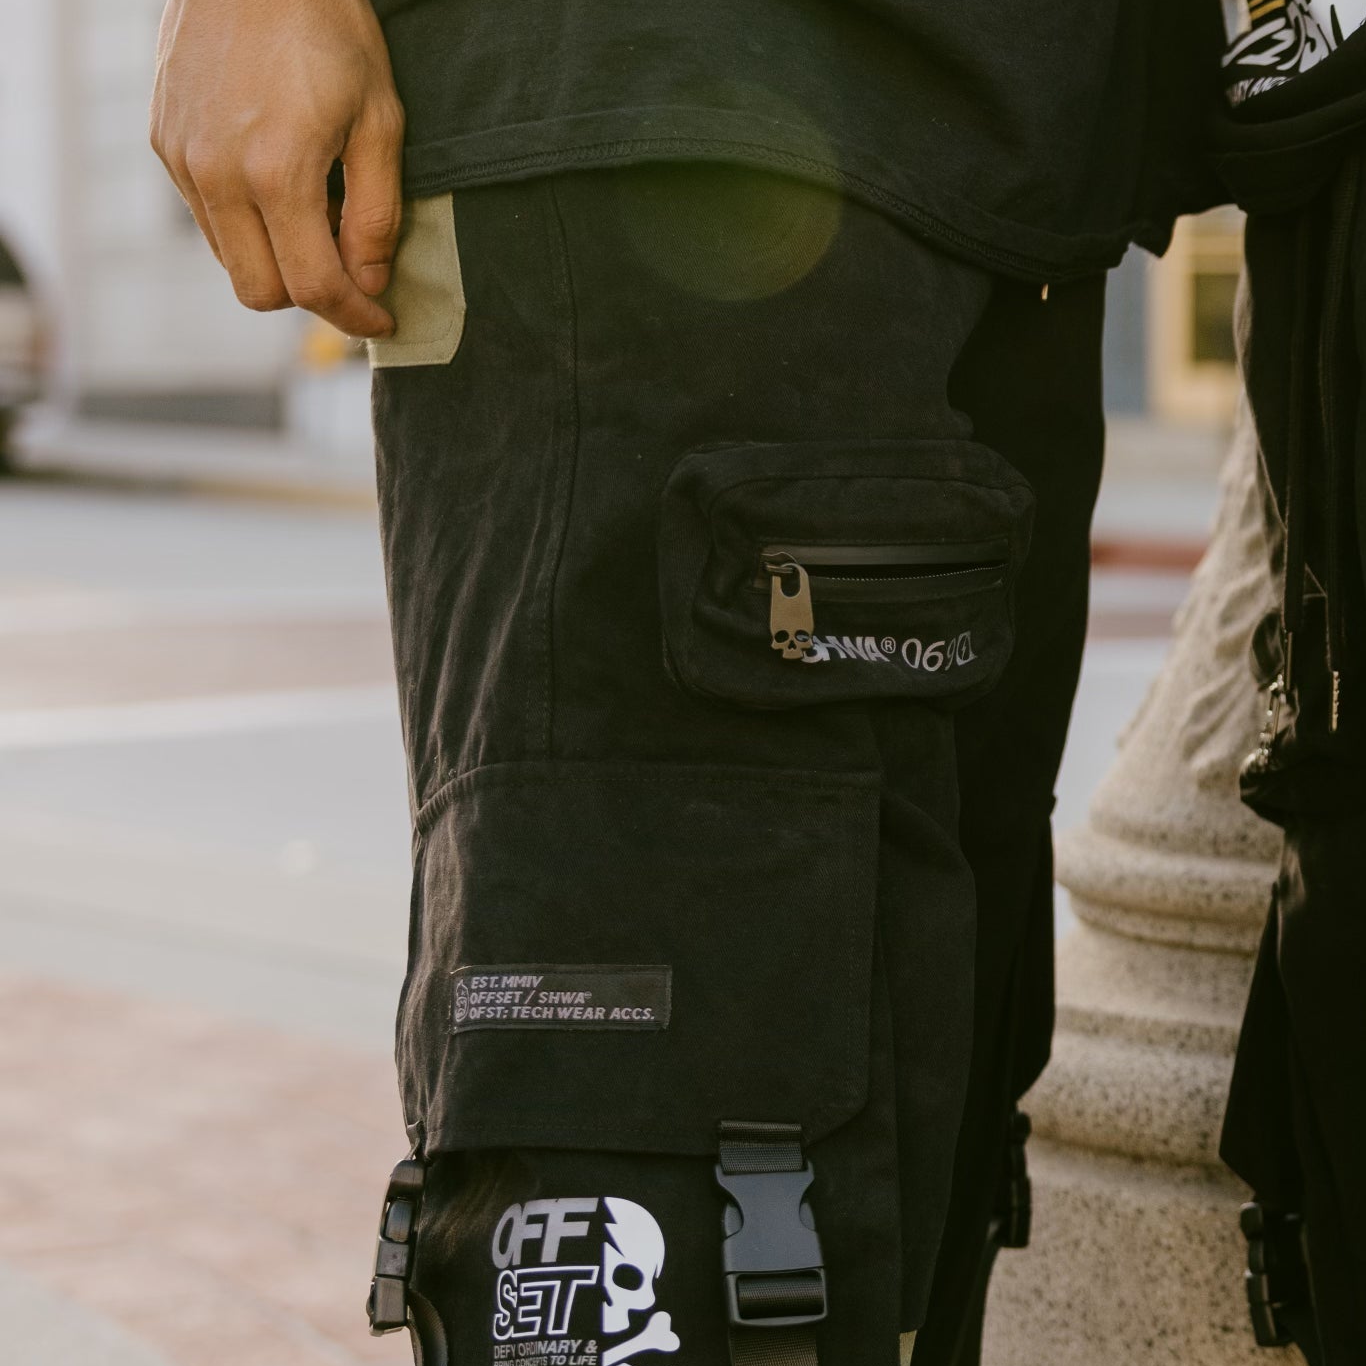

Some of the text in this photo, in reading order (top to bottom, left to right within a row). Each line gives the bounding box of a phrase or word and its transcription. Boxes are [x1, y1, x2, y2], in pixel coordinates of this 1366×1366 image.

[470, 976, 544, 989] EST. MMIV
[469, 991, 523, 1004] OFFSET
[469, 1006, 655, 1020] OFST: TECH WEAR ACCS.
[492, 1197, 599, 1269] OFF
[493, 1265, 600, 1340] SET
[493, 1339, 598, 1359] DEFY ORDINARY &
[550, 1355, 566, 1365] TO
[568, 1355, 598, 1366] LIFE
